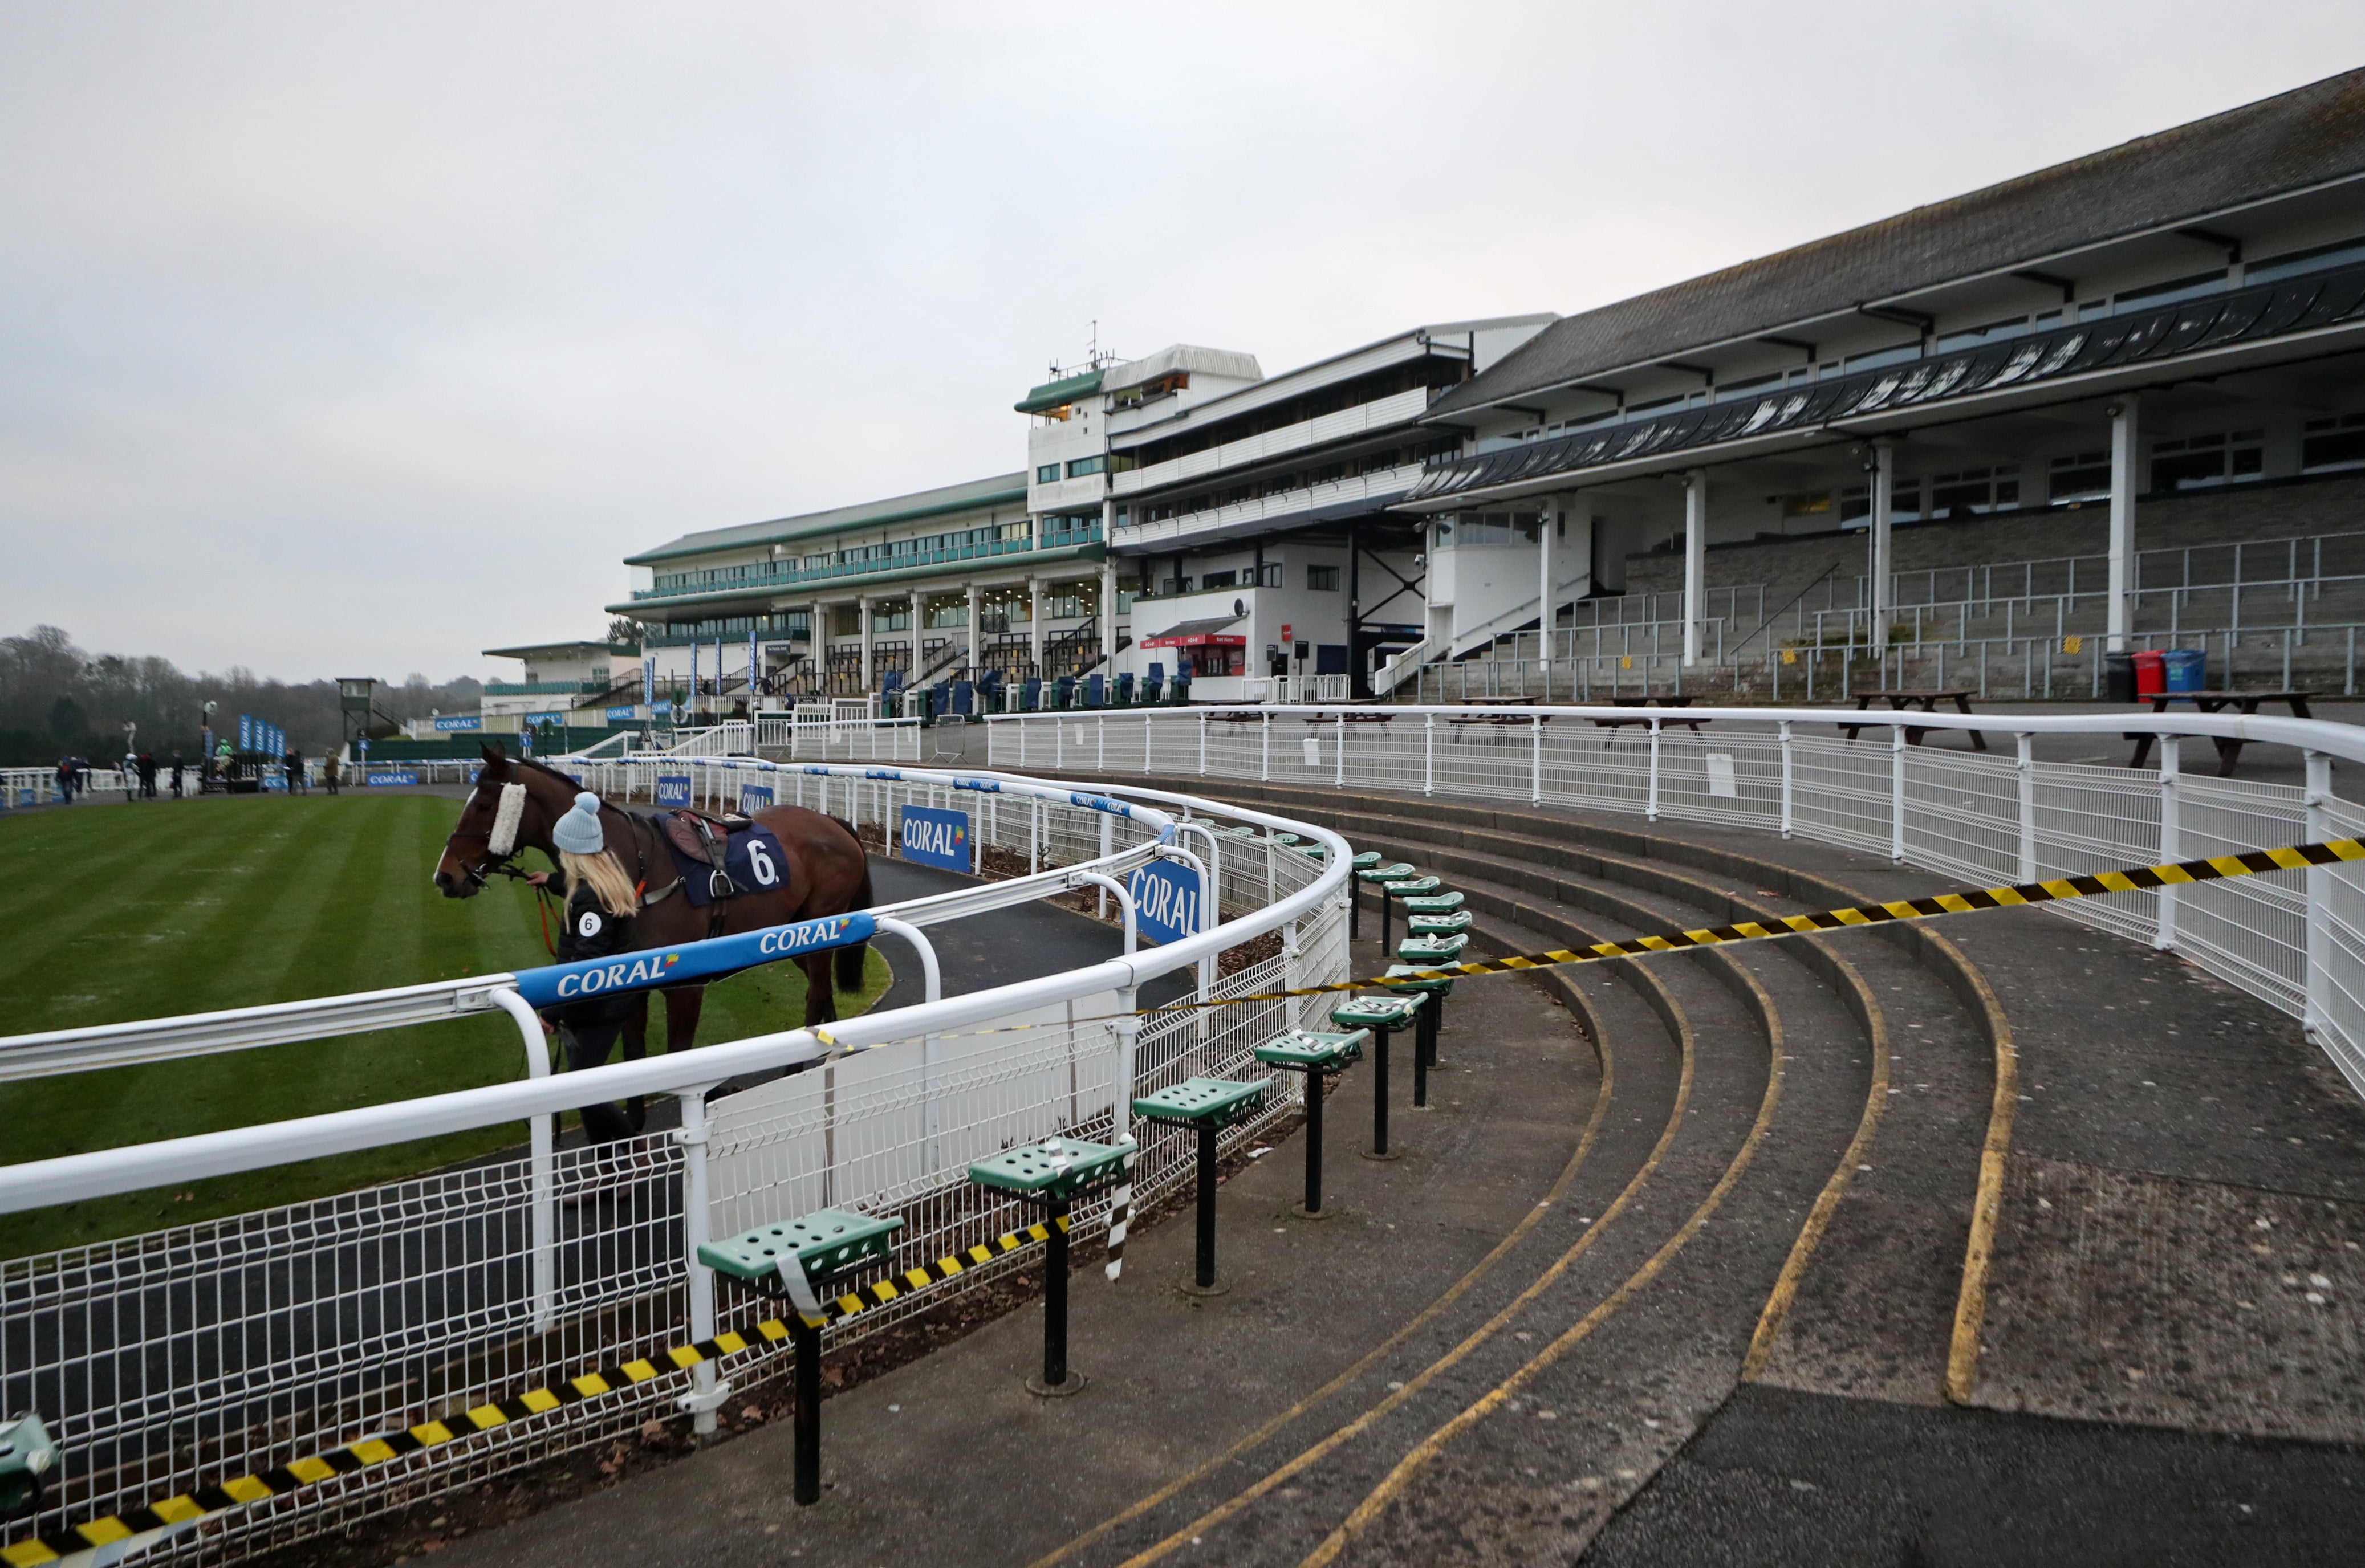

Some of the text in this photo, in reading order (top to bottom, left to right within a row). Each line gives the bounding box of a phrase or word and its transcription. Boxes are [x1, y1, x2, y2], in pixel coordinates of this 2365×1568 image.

[607, 708, 631, 719] CORAL
[436, 719, 472, 729] CORAL
[370, 774, 409, 784] CORAL
[659, 783, 683, 800] CORAL
[1076, 795, 1123, 813] CORAL CORAL
[904, 818, 954, 857] CORAL
[1130, 868, 1200, 938] CORAL
[584, 918, 592, 931] 6
[557, 920, 841, 998] CORAL CORAL
